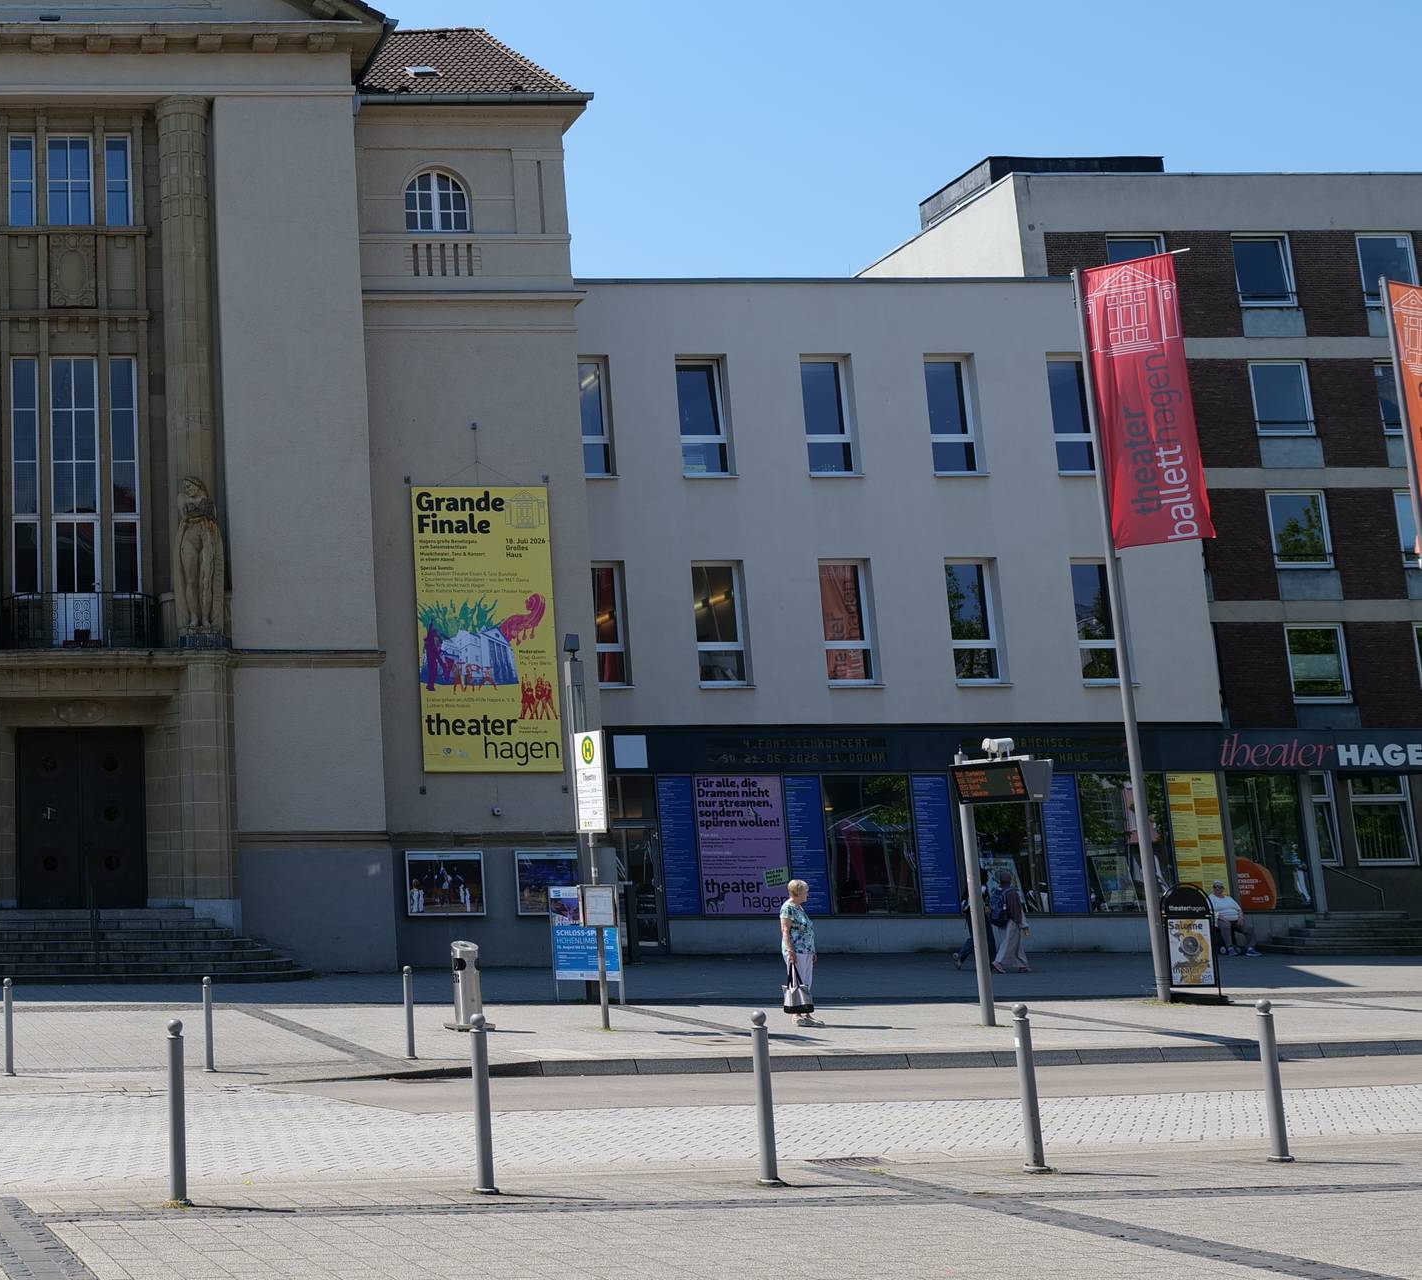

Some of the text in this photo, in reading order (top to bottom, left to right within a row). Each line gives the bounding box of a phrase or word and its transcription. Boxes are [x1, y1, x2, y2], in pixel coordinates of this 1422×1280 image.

[1122, 406, 1159, 515] theater
[416, 490, 505, 512] Grande
[417, 513, 491, 534] Finale
[425, 713, 518, 736] theater
[484, 736, 560, 766] hagen
[1219, 733, 1335, 767] theater
[696, 778, 757, 789] Für alle, die
[697, 788, 770, 798] Dramen nicht
[698, 799, 773, 808] nur streamen,
[698, 808, 743, 817] sondern
[699, 817, 780, 830] spüren wollen!
[705, 879, 764, 893] theater
[1169, 905, 1206, 913] theaterhagen
